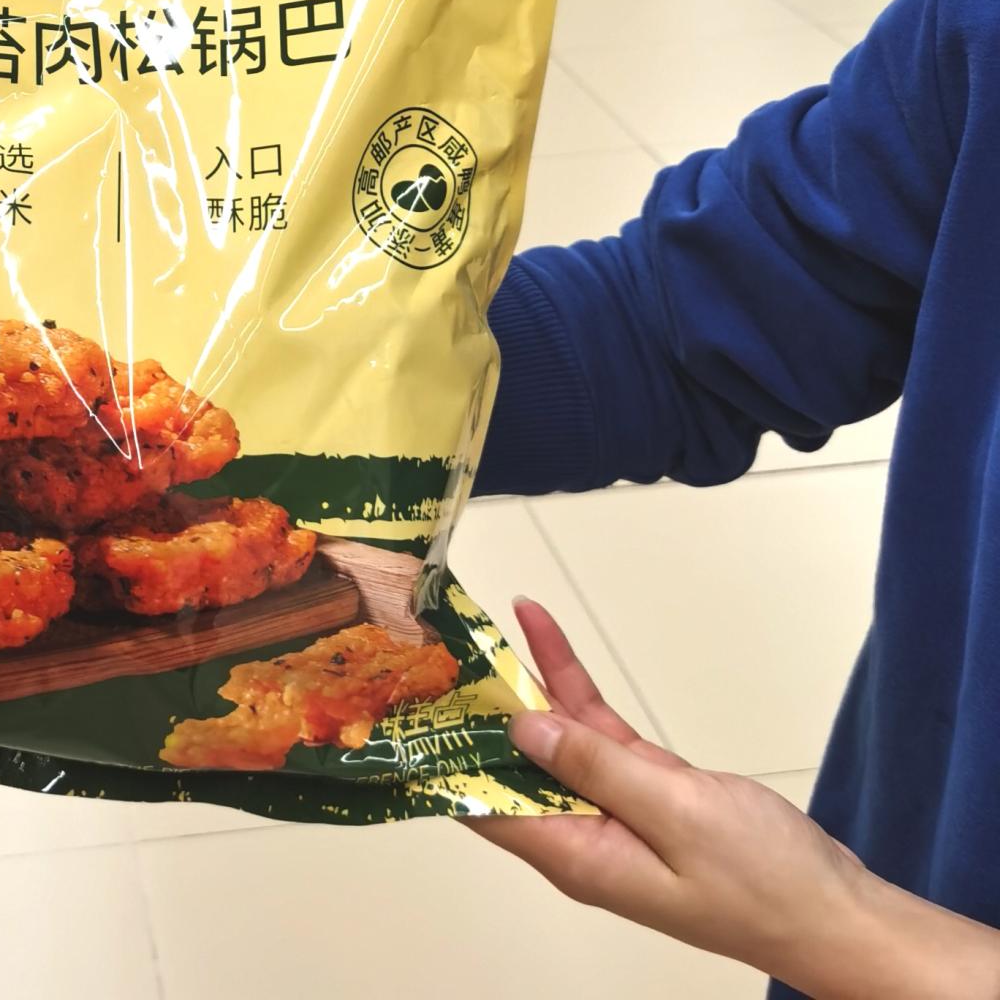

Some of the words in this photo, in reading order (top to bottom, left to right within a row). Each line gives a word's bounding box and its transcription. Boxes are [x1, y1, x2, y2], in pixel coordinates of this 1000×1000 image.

[205, 142, 284, 182] 入口
[206, 193, 289, 236] 酥脆
[436, 751, 482, 778] ONLY
